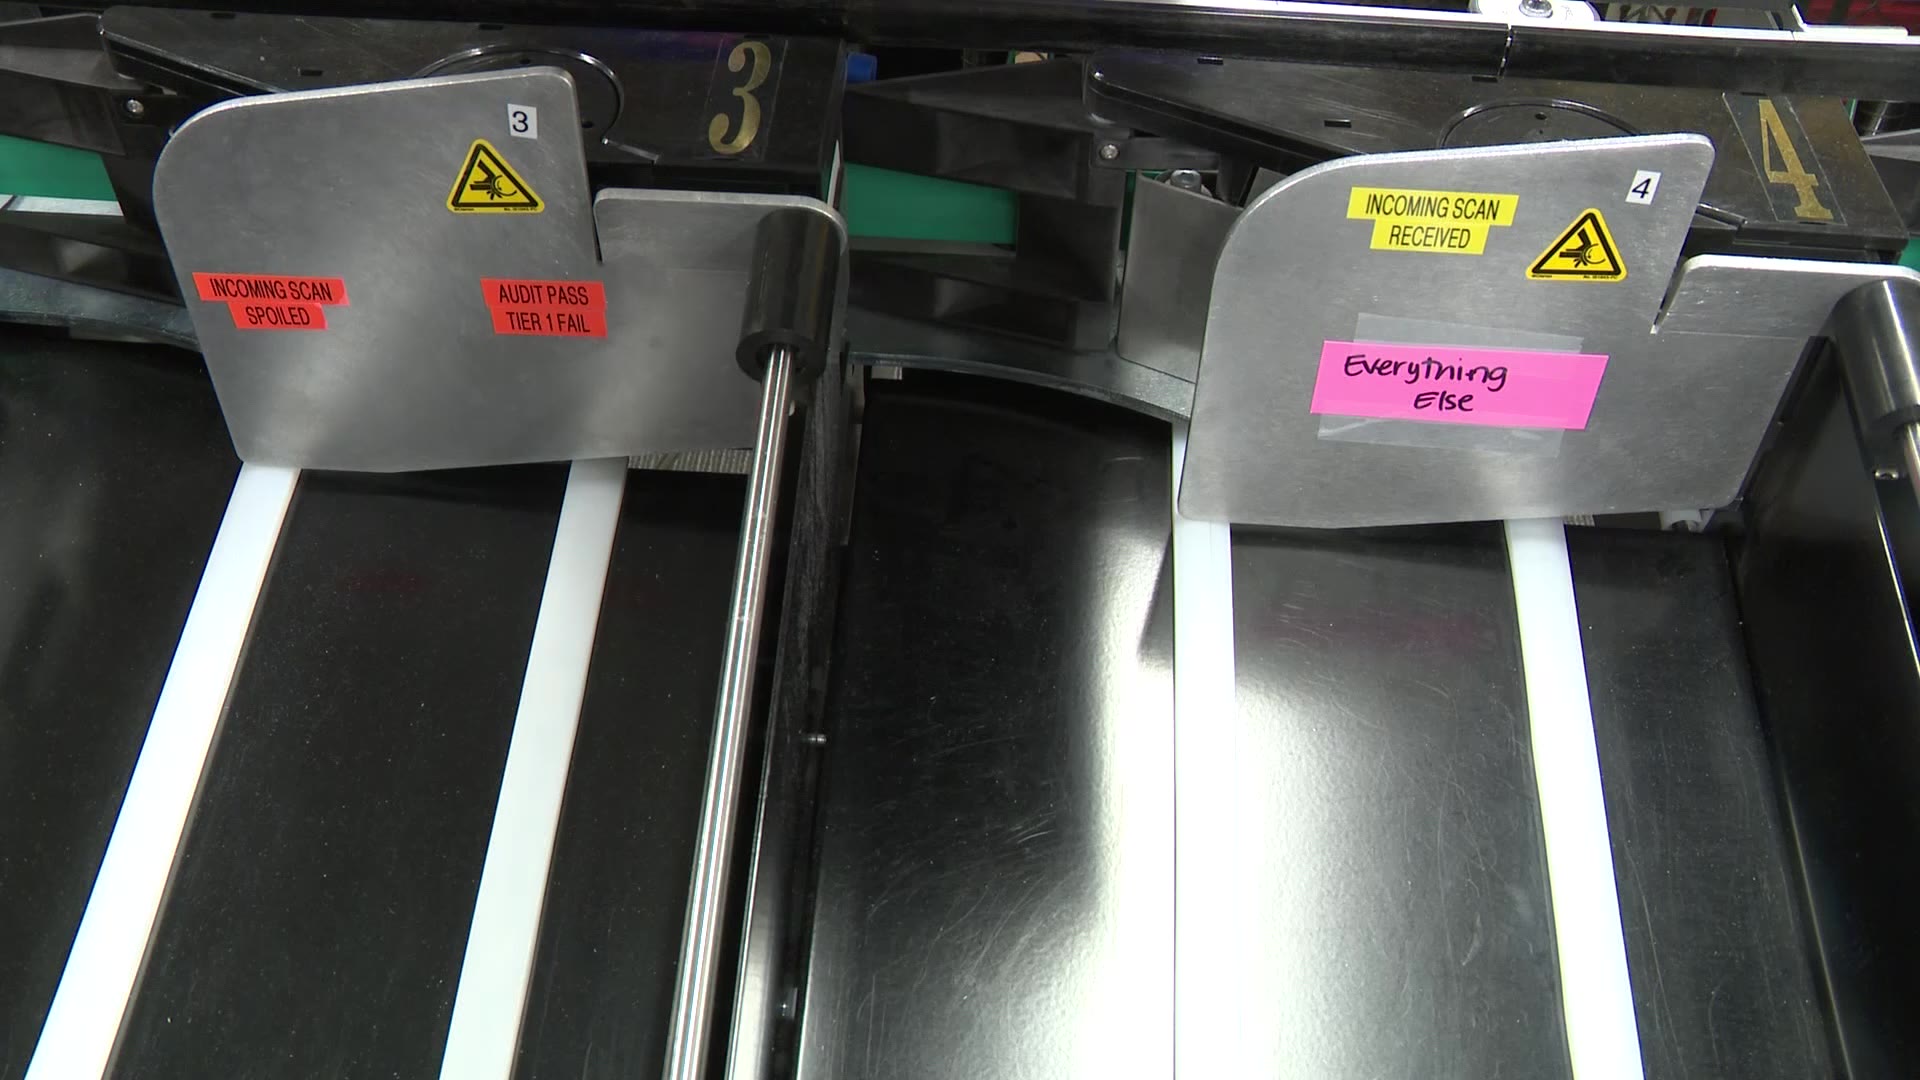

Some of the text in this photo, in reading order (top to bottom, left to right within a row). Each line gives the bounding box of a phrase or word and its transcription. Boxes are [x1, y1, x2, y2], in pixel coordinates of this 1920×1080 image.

[708, 41, 771, 154] 3
[512, 110, 529, 133] 3
[1758, 99, 1834, 220] 4
[1631, 178, 1652, 199] 4
[1365, 193, 1501, 221] INCOMING SCAN
[1388, 225, 1472, 249] RECEIVED
[210, 277, 333, 302] INCOMING SCAN
[499, 283, 590, 306] AUDIT PASS
[245, 305, 311, 326] SPOILED
[505, 311, 591, 333] TIER 1 FAIL
[1343, 353, 1508, 392] Everything
[1413, 390, 1474, 412] Else
